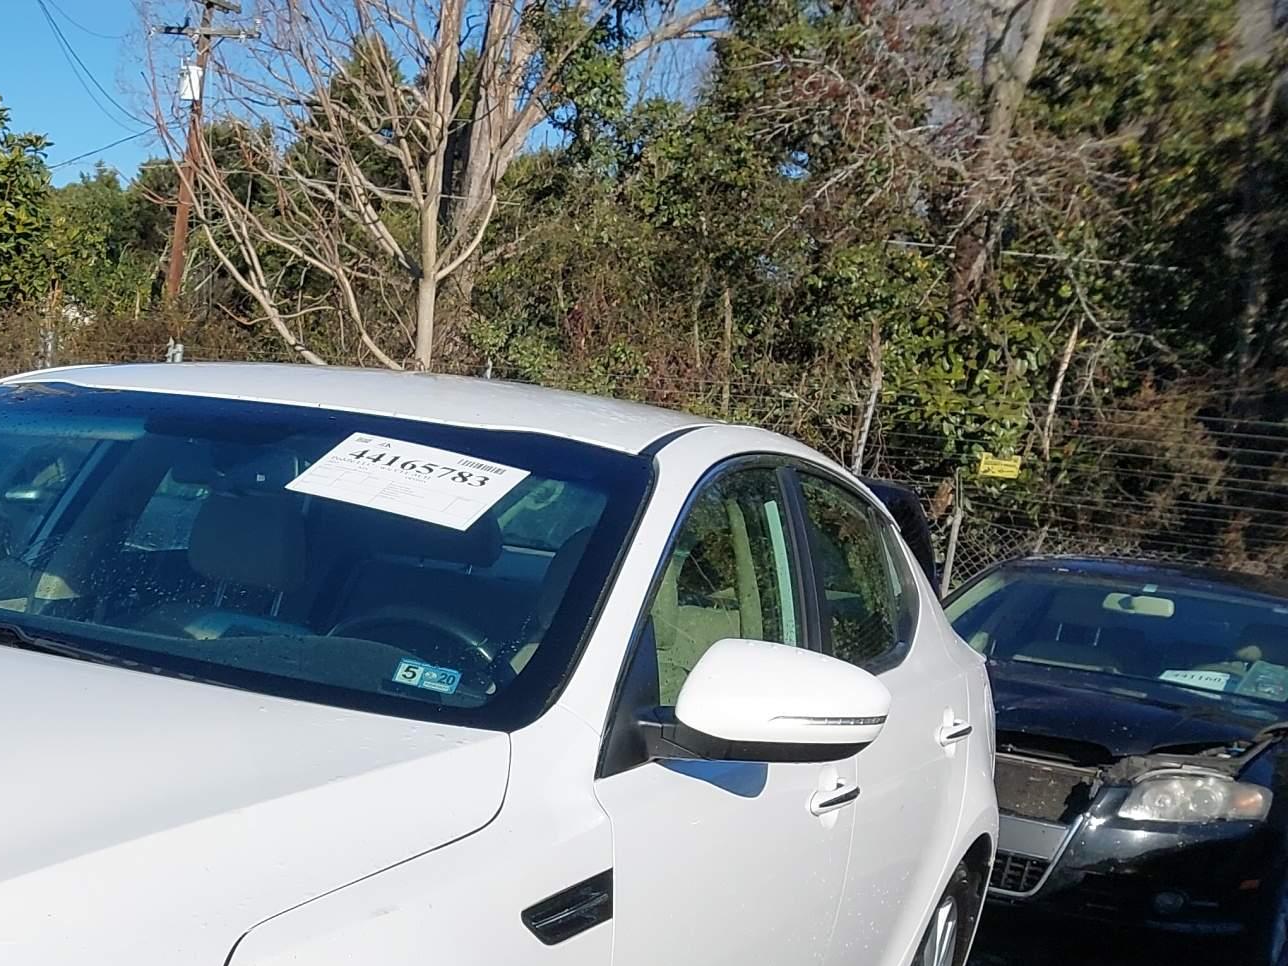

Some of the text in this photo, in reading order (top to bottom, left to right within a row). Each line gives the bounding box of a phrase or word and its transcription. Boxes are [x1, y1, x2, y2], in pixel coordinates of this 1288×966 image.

[349, 449, 491, 488] 44165783
[401, 665, 456, 686] 5 20
